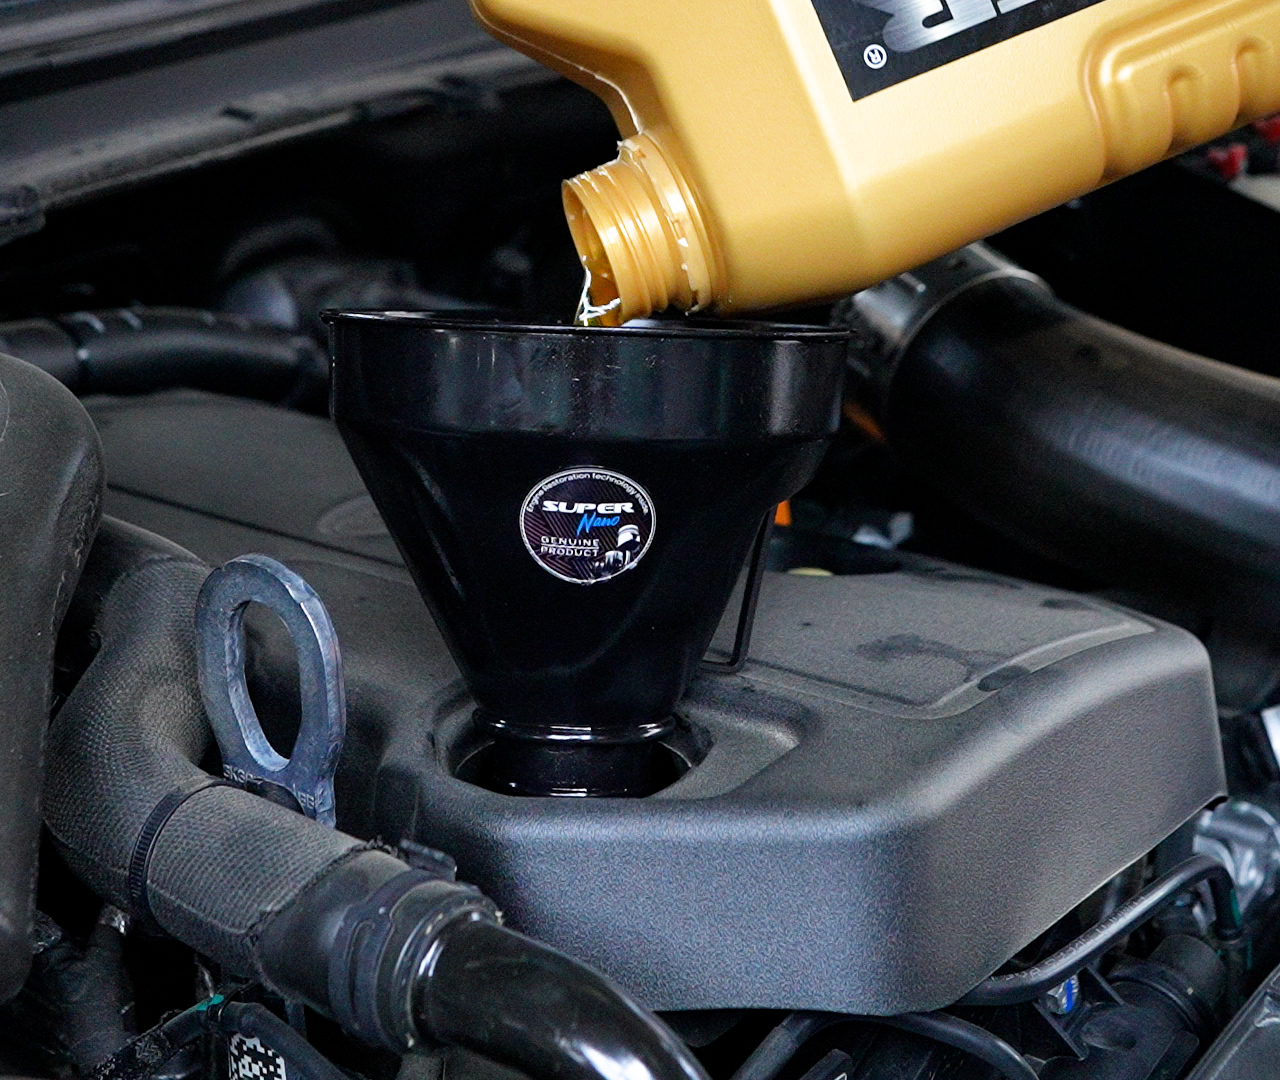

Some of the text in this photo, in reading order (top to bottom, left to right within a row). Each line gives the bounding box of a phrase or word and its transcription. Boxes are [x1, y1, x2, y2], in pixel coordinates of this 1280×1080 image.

[541, 473, 591, 492] Restoration
[542, 500, 635, 514] SUPER
[576, 511, 620, 536] Nano
[540, 535, 600, 546] GENUINE
[540, 546, 600, 557] PRODUCT
